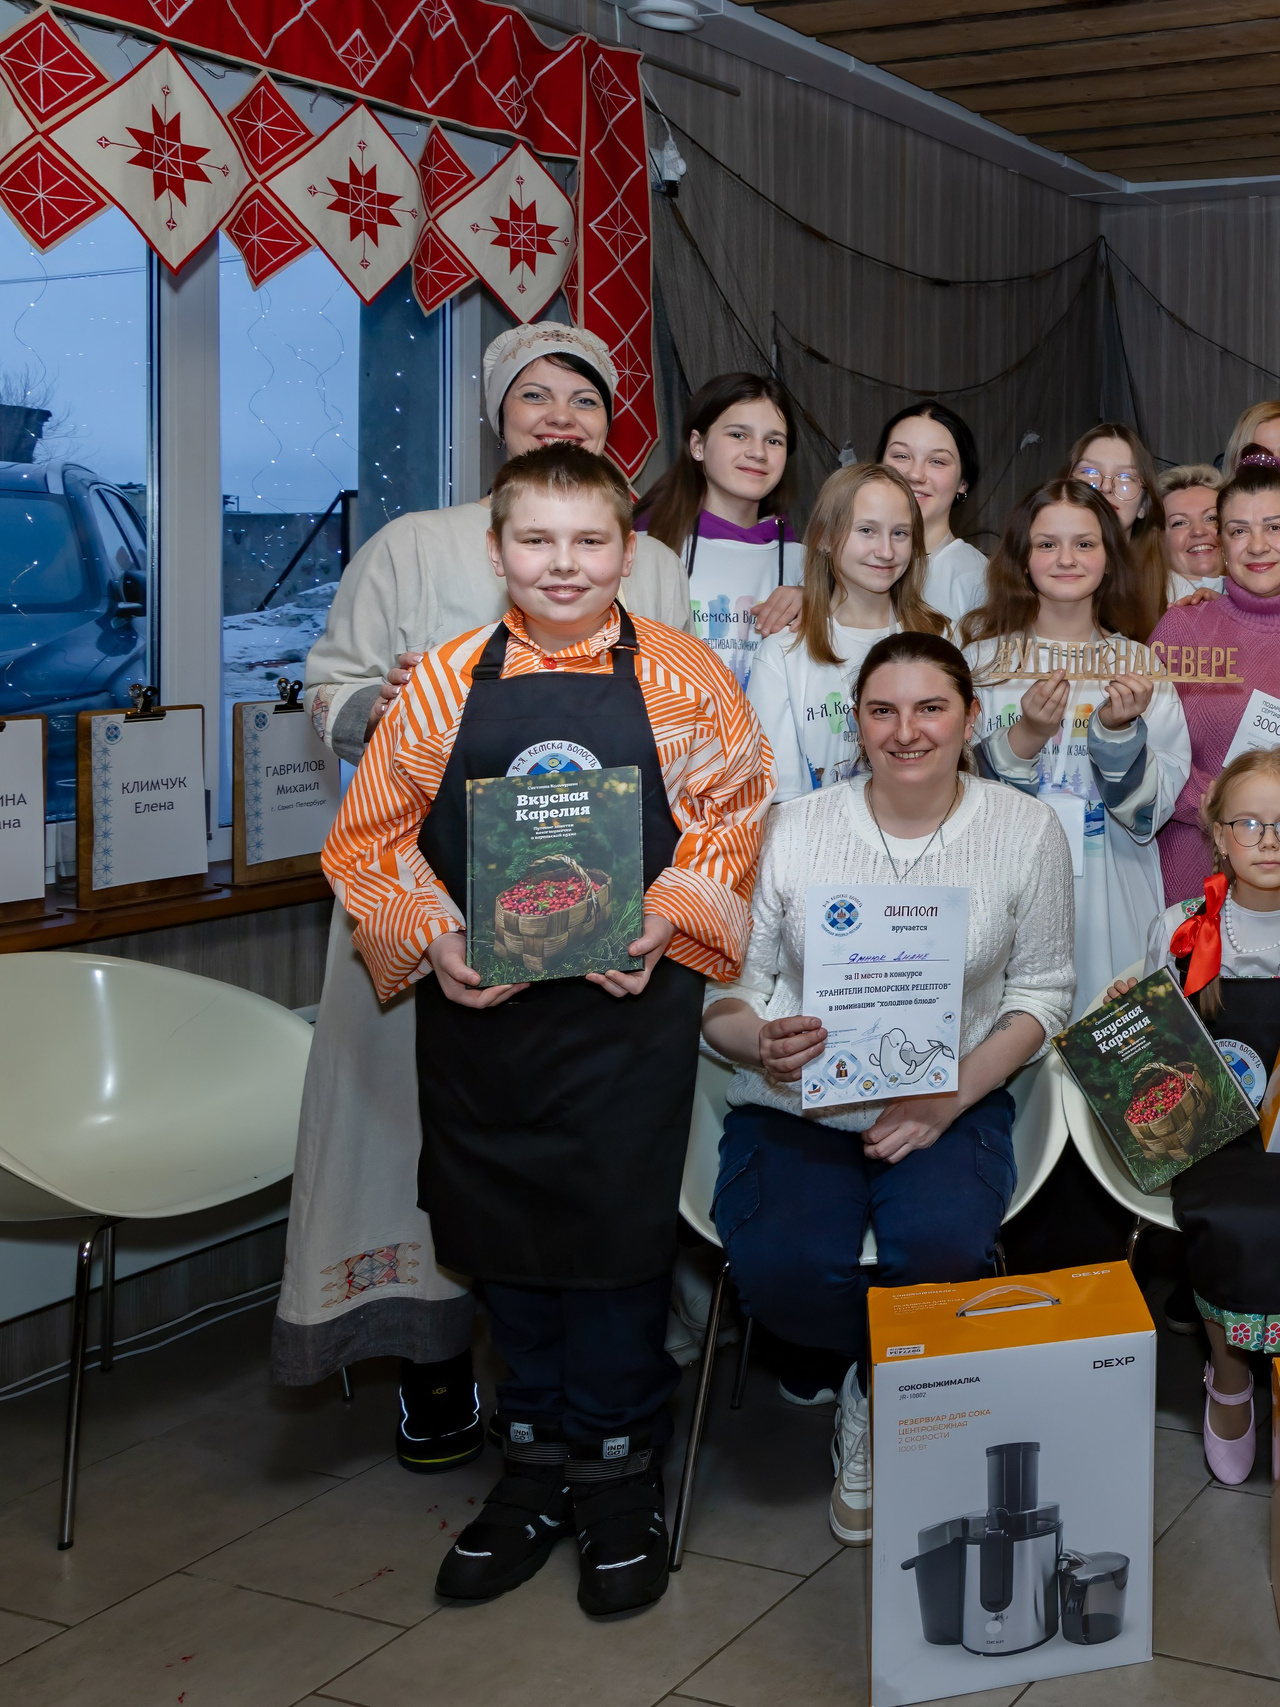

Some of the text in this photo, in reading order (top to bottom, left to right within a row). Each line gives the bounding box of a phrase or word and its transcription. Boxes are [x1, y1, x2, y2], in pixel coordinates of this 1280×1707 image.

[693, 610, 739, 623] Кемска
[528, 742, 563, 757] КЕМСКА
[566, 743, 598, 768] ВОЛОСТЬ
[265, 760, 326, 777] ГАВРИЛОВ
[121, 776, 187, 794] КЛИМЧУК
[276, 782, 319, 796] Михаил
[516, 791, 589, 808] Вкусная
[134, 801, 175, 815] Елена
[515, 805, 590, 823] Карелия
[0, 818, 21, 829] на
[884, 905, 939, 917] ДИПЛОМ
[891, 925, 928, 933] вручается
[889, 970, 922, 979] конкурсе
[864, 984, 910, 994] ПОМОРСКИХ
[834, 1002, 876, 1011] номинации
[1091, 1005, 1144, 1042] Вкусная
[1097, 1015, 1152, 1054] Карелия
[1071, 1269, 1111, 1278] DEXP
[1092, 1356, 1136, 1369] DEXP
[898, 1376, 981, 1392] СОКОВЫЖИМАЛКА
[898, 1409, 991, 1426] РЕЗЕРВУАР ДЛЯ СОКА
[898, 1420, 968, 1435] ЦЕНТРОБЕЖНАЯ
[904, 1432, 950, 1443] СКОРОСТИ
